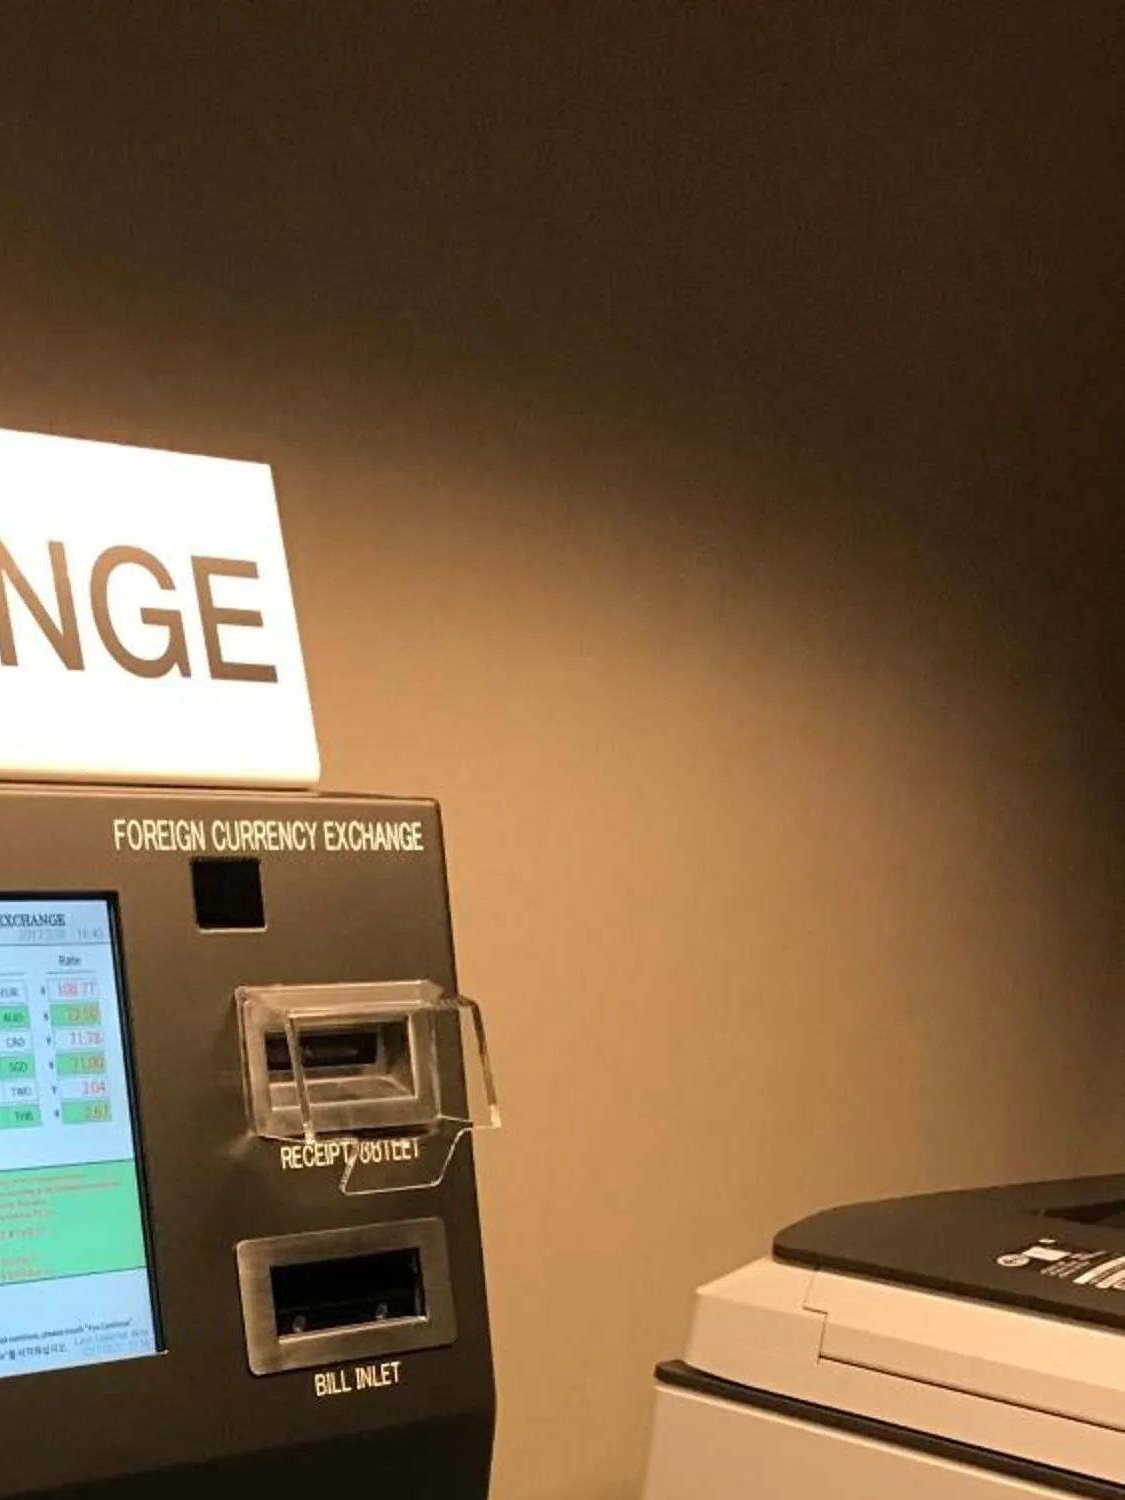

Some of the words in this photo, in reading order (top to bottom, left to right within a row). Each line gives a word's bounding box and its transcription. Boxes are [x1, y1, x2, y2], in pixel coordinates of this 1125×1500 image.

[113, 819, 206, 850] FOREIGN
[211, 820, 317, 851] CURRENCY
[322, 821, 424, 851] EXCHANGE
[58, 955, 82, 966] Rate
[280, 1141, 349, 1169] RECEIPT
[315, 1369, 352, 1396] BILL
[355, 1361, 401, 1390] INLET
